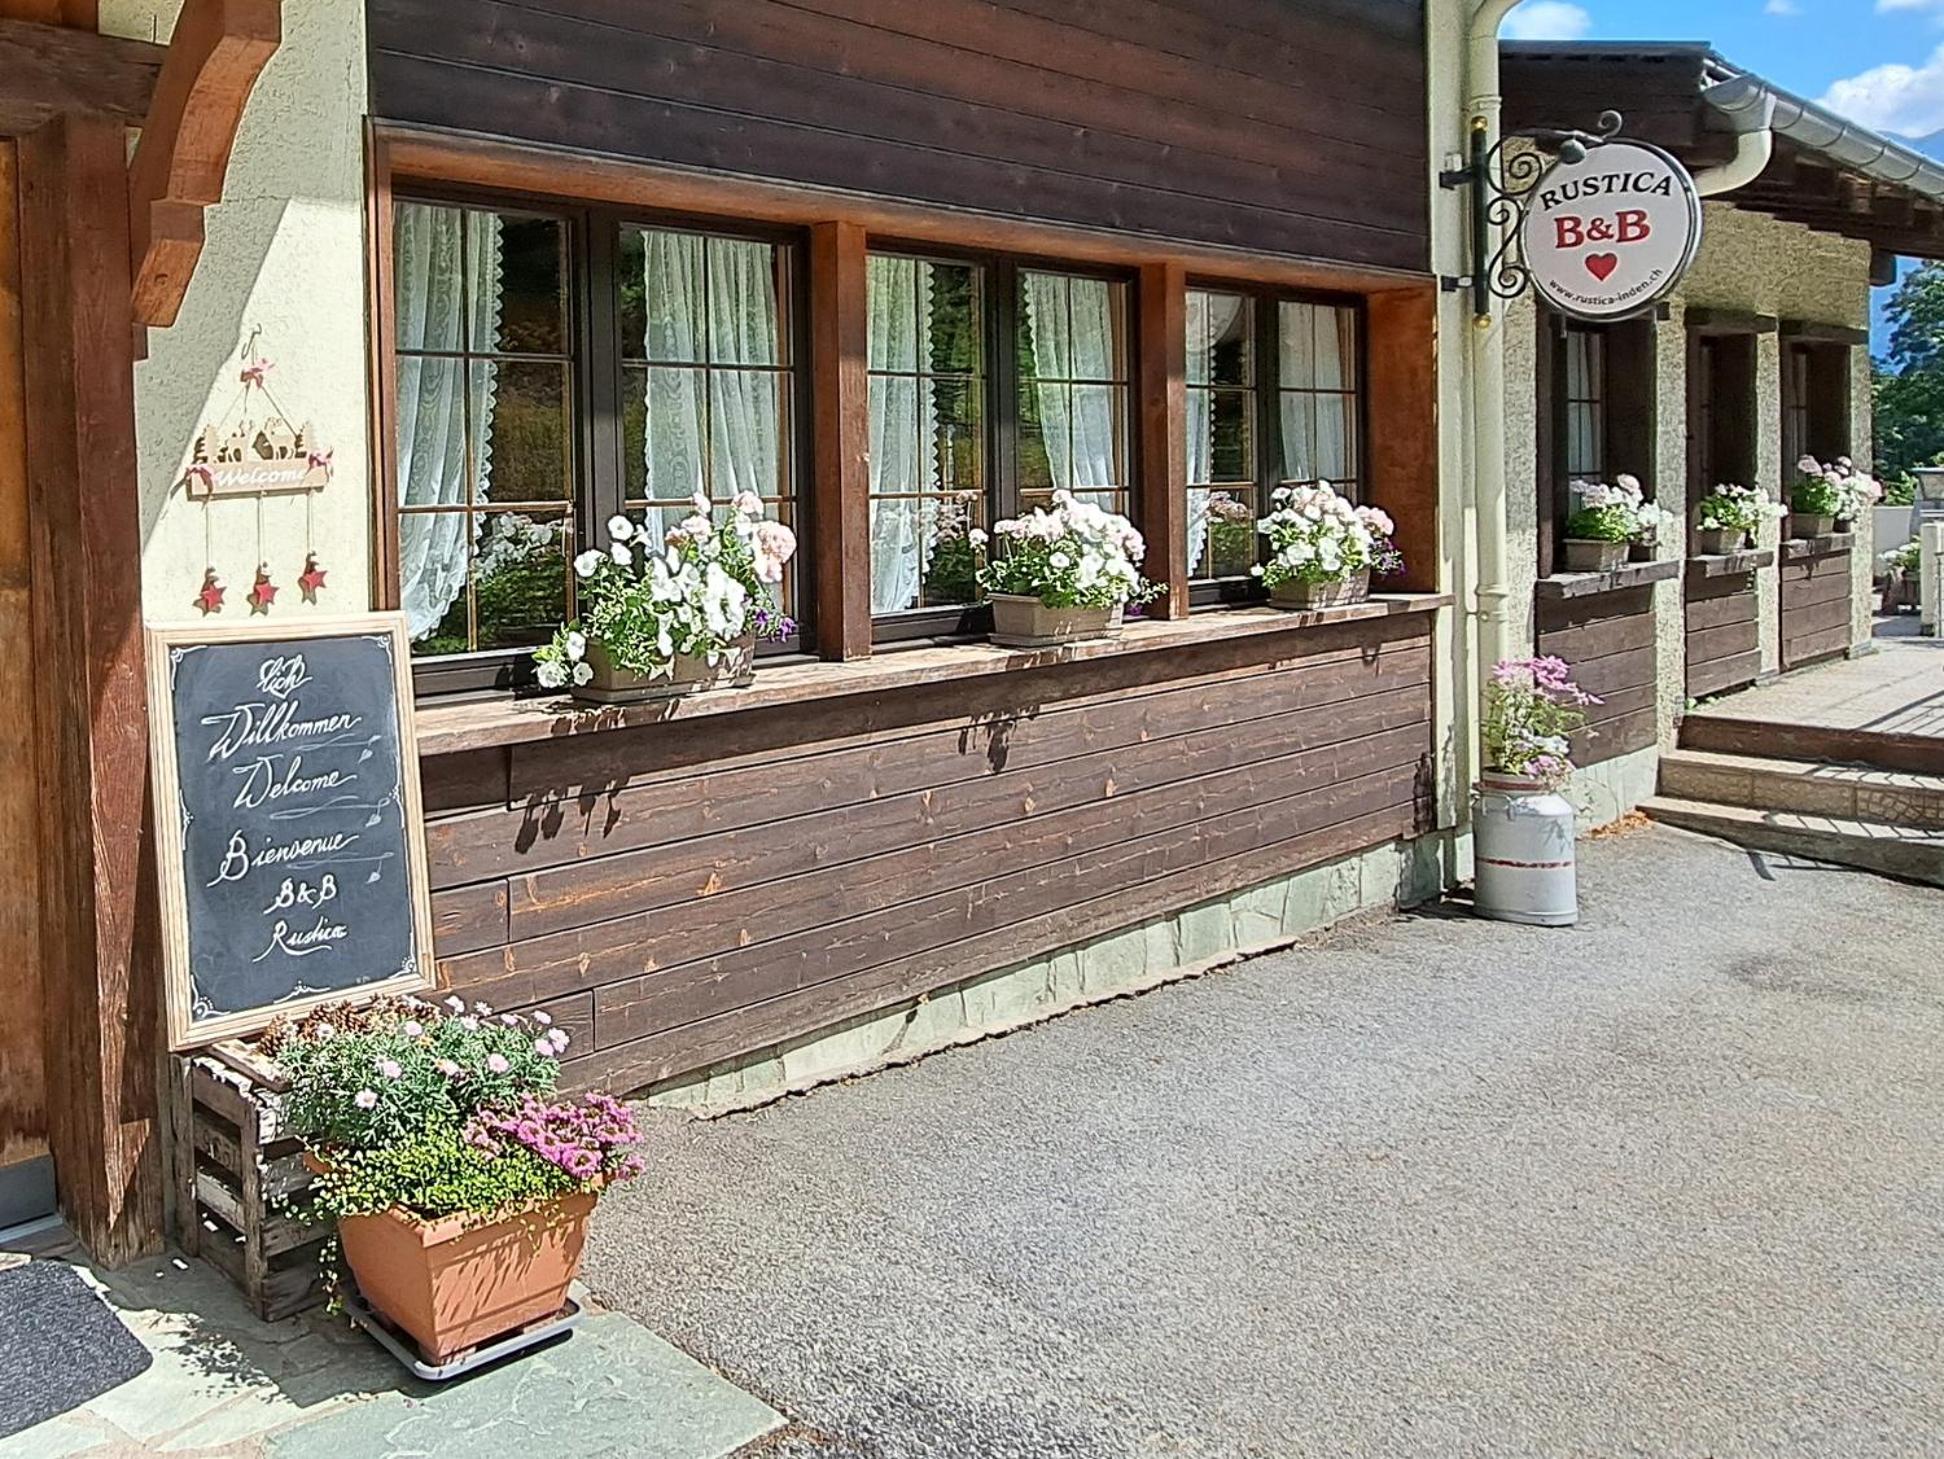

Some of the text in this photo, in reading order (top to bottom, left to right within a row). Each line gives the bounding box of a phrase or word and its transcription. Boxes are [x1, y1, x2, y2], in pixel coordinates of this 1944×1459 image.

[1540, 171, 1673, 211] RUSTICA
[1553, 209, 1651, 249] B&B
[1548, 268, 1663, 305] www.rustica-inden.ch
[201, 700, 362, 761] Willkommen
[232, 754, 358, 809] Welcome
[206, 829, 360, 888] Bienvenue
[252, 916, 348, 963] Rustica
